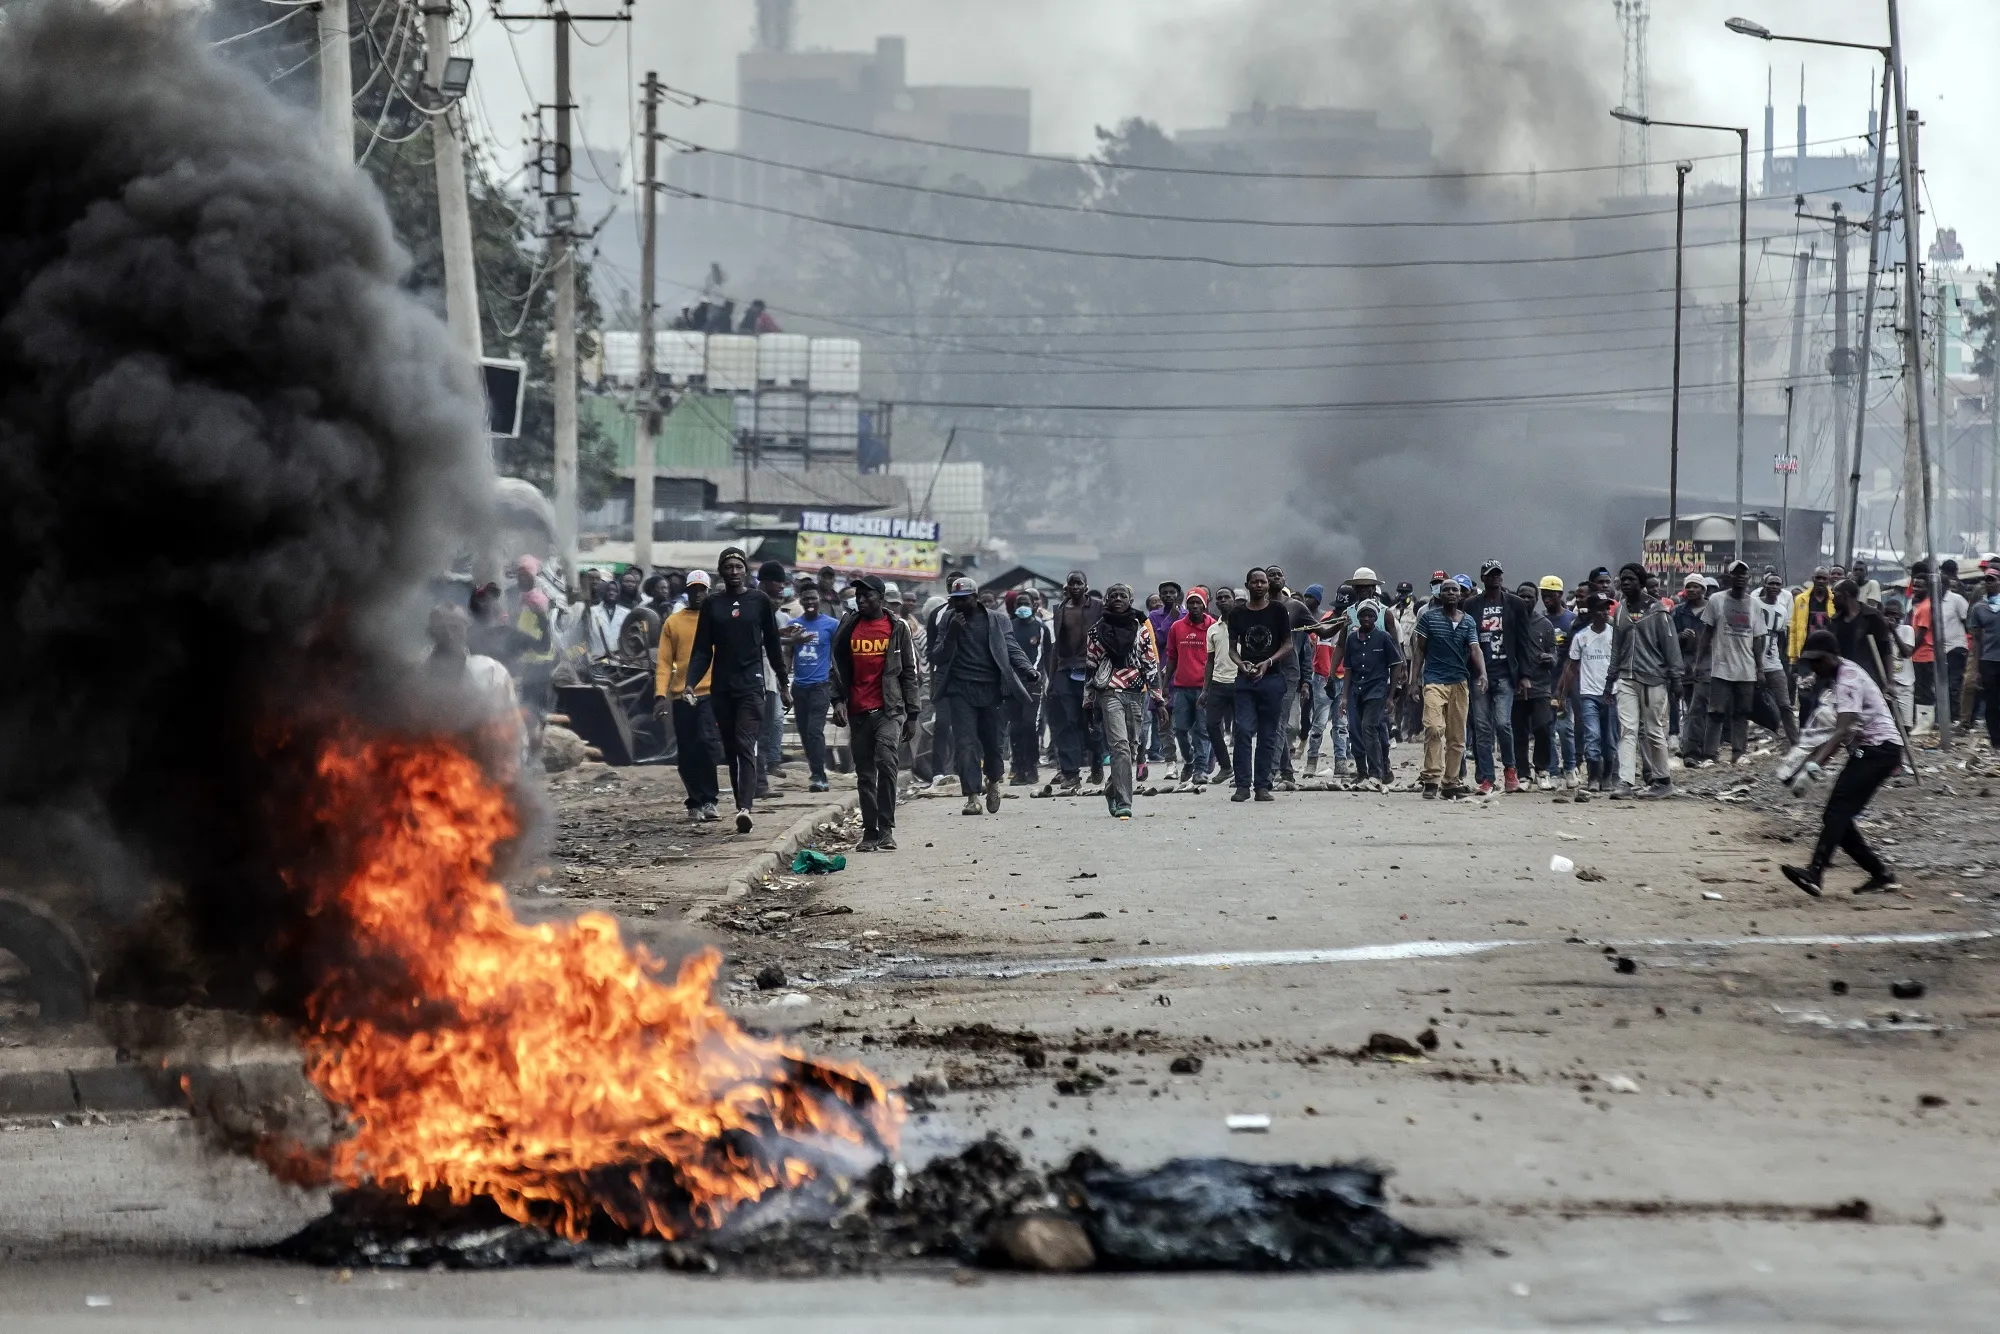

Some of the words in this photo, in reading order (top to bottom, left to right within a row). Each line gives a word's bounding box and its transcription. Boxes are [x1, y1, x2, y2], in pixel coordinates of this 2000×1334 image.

[802, 512, 829, 532] THE
[830, 513, 892, 536] CHICKEN
[892, 518, 936, 540] PLACE
[1665, 540, 1693, 553] SDE
[851, 638, 890, 653] UDM
[1586, 653, 1611, 661] Emirate
